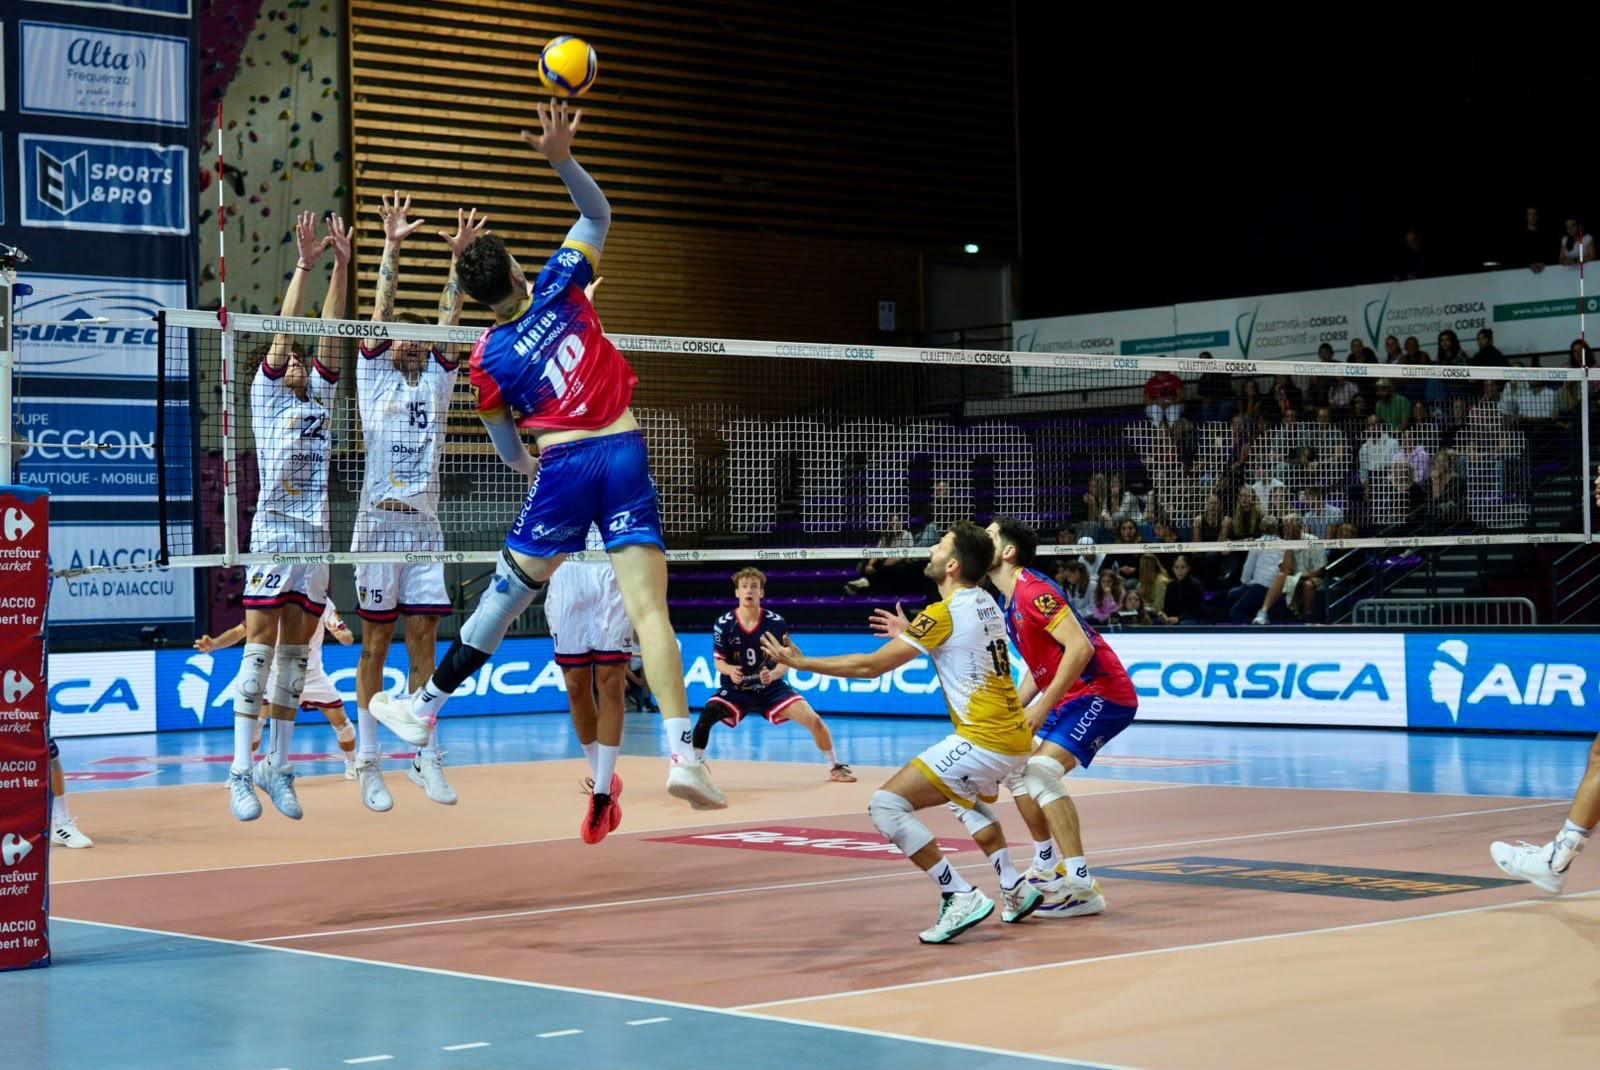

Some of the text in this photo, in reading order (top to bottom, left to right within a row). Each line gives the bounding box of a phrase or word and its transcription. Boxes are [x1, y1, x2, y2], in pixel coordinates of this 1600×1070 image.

[67, 68, 131, 85] Frequenza
[90, 163, 173, 185] SPORTS
[91, 186, 153, 205] &PRO
[1444, 302, 1486, 316] CORSICA
[1309, 315, 1348, 328] CORSICA
[1454, 318, 1487, 330] CORSE
[337, 323, 389, 337] CORSICA
[540, 321, 568, 350] FORMA
[1081, 337, 1115, 349] CORSICA
[1320, 331, 1348, 343] CORSE
[682, 341, 726, 353] CORSICA
[844, 349, 875, 359] CORSE
[974, 353, 1011, 364] CORSICA
[1113, 358, 1139, 368] CORSE
[1225, 362, 1257, 372] CORSICA
[406, 402, 428, 429] 15
[301, 415, 325, 440] 22
[862, 549, 900, 558] Gamm vert
[1075, 546, 1088, 554] vert
[1163, 544, 1176, 552] vert
[272, 553, 324, 565] Gamm vert
[405, 552, 453, 563] Gamm vert
[673, 551, 689, 560] vert
[757, 550, 798, 560] Gamm vert
[0, 560, 33, 572] arket
[69, 577, 174, 597] CITÀ D'AIACCIU
[264, 573, 281, 589] 22
[370, 589, 383, 604] 15
[0, 597, 36, 609] ACCIO
[0, 613, 39, 625] ert 1er
[746, 648, 756, 666] 9
[1127, 661, 1587, 706] CORSICA AIR
[0, 722, 32, 734] arket
[0, 760, 37, 772] ACCIO
[23, 776, 40, 788] 1er
[0, 919, 37, 933] ACCIO
[23, 936, 40, 948] 1er
